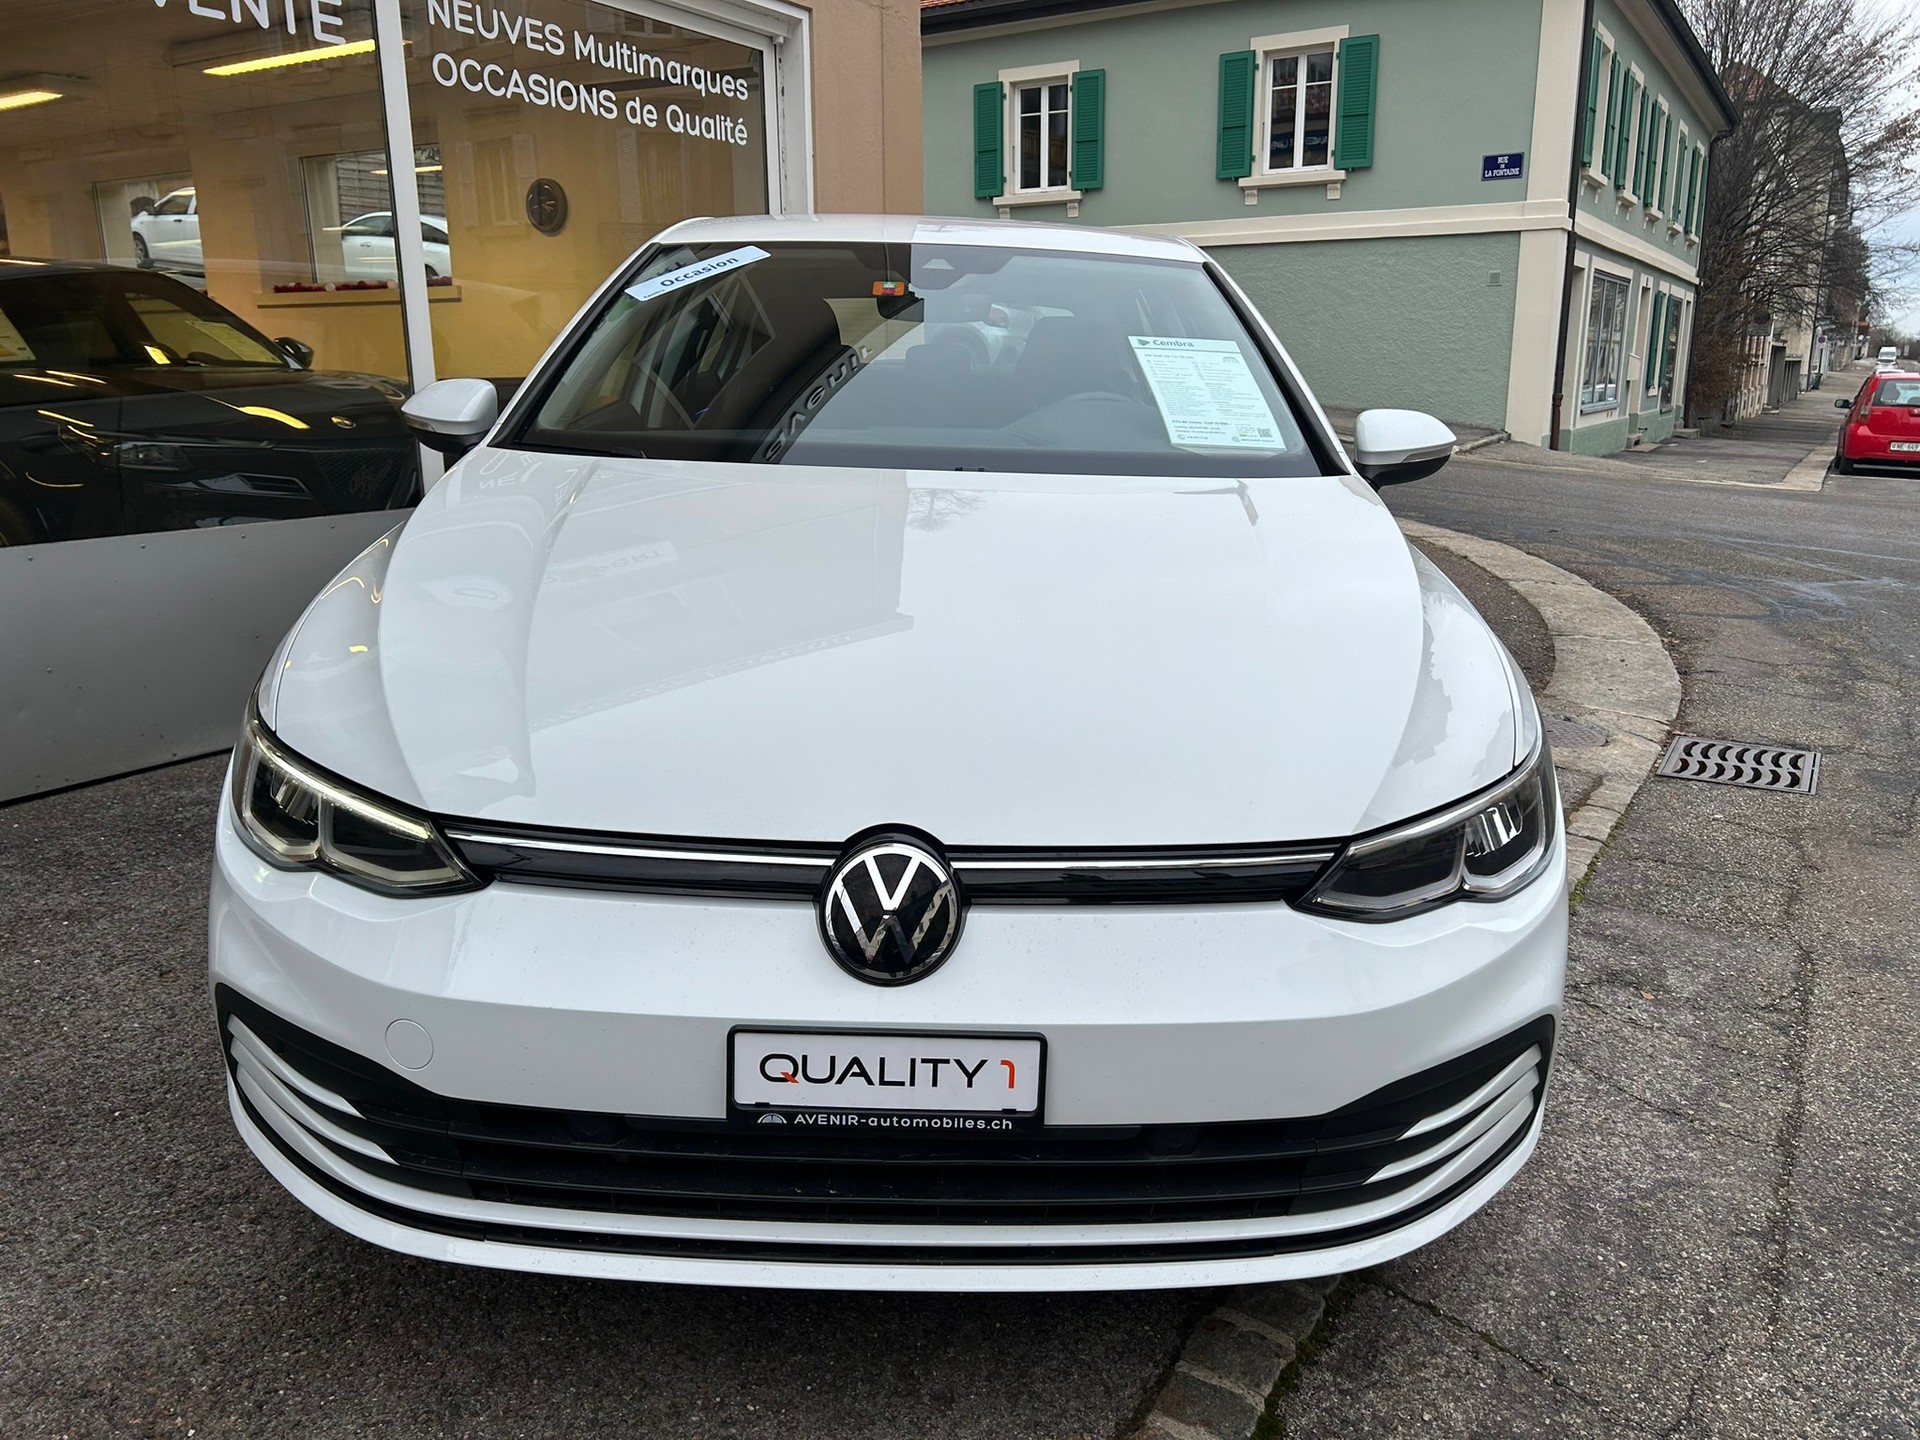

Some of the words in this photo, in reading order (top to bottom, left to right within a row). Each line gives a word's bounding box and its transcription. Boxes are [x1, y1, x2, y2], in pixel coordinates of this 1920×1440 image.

[427, 0, 565, 56] NEUVES
[574, 30, 749, 101] Multimarques
[431, 52, 618, 120] OCCASIONS
[625, 96, 658, 128] de
[665, 104, 748, 146] Qualité
[1493, 168, 1519, 176] FONTAINE
[1497, 156, 1509, 164] RUE
[659, 256, 740, 287] Occasion
[1152, 339, 1195, 348] Cembra
[759, 1053, 989, 1089] QUALITY
[1000, 1059, 1015, 1089] 1
[794, 1113, 1013, 1130] AVENIR-automobiles.ch
